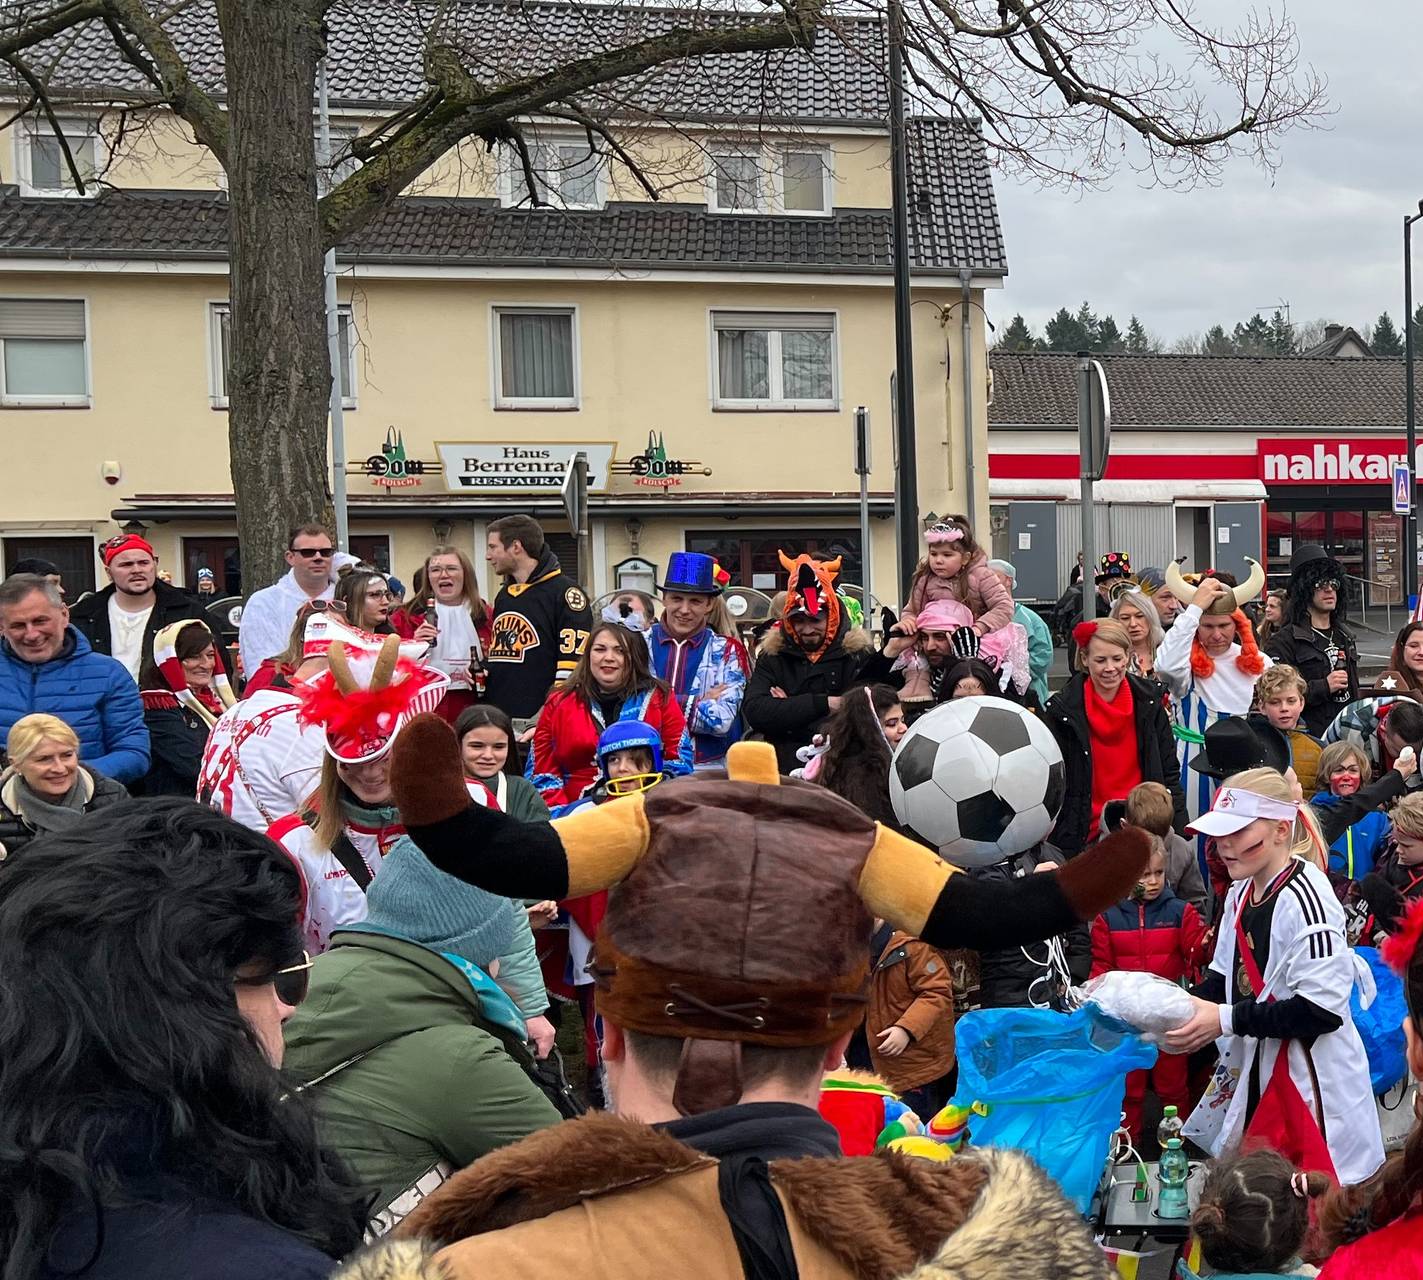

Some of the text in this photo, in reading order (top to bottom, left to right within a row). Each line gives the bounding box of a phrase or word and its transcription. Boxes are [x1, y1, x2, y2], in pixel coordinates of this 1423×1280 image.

[502, 447, 550, 459] Haus
[463, 457, 591, 473] Berrenra
[470, 476, 562, 487] RESTAURA
[490, 616, 534, 646] RUINS
[560, 628, 591, 655] 37
